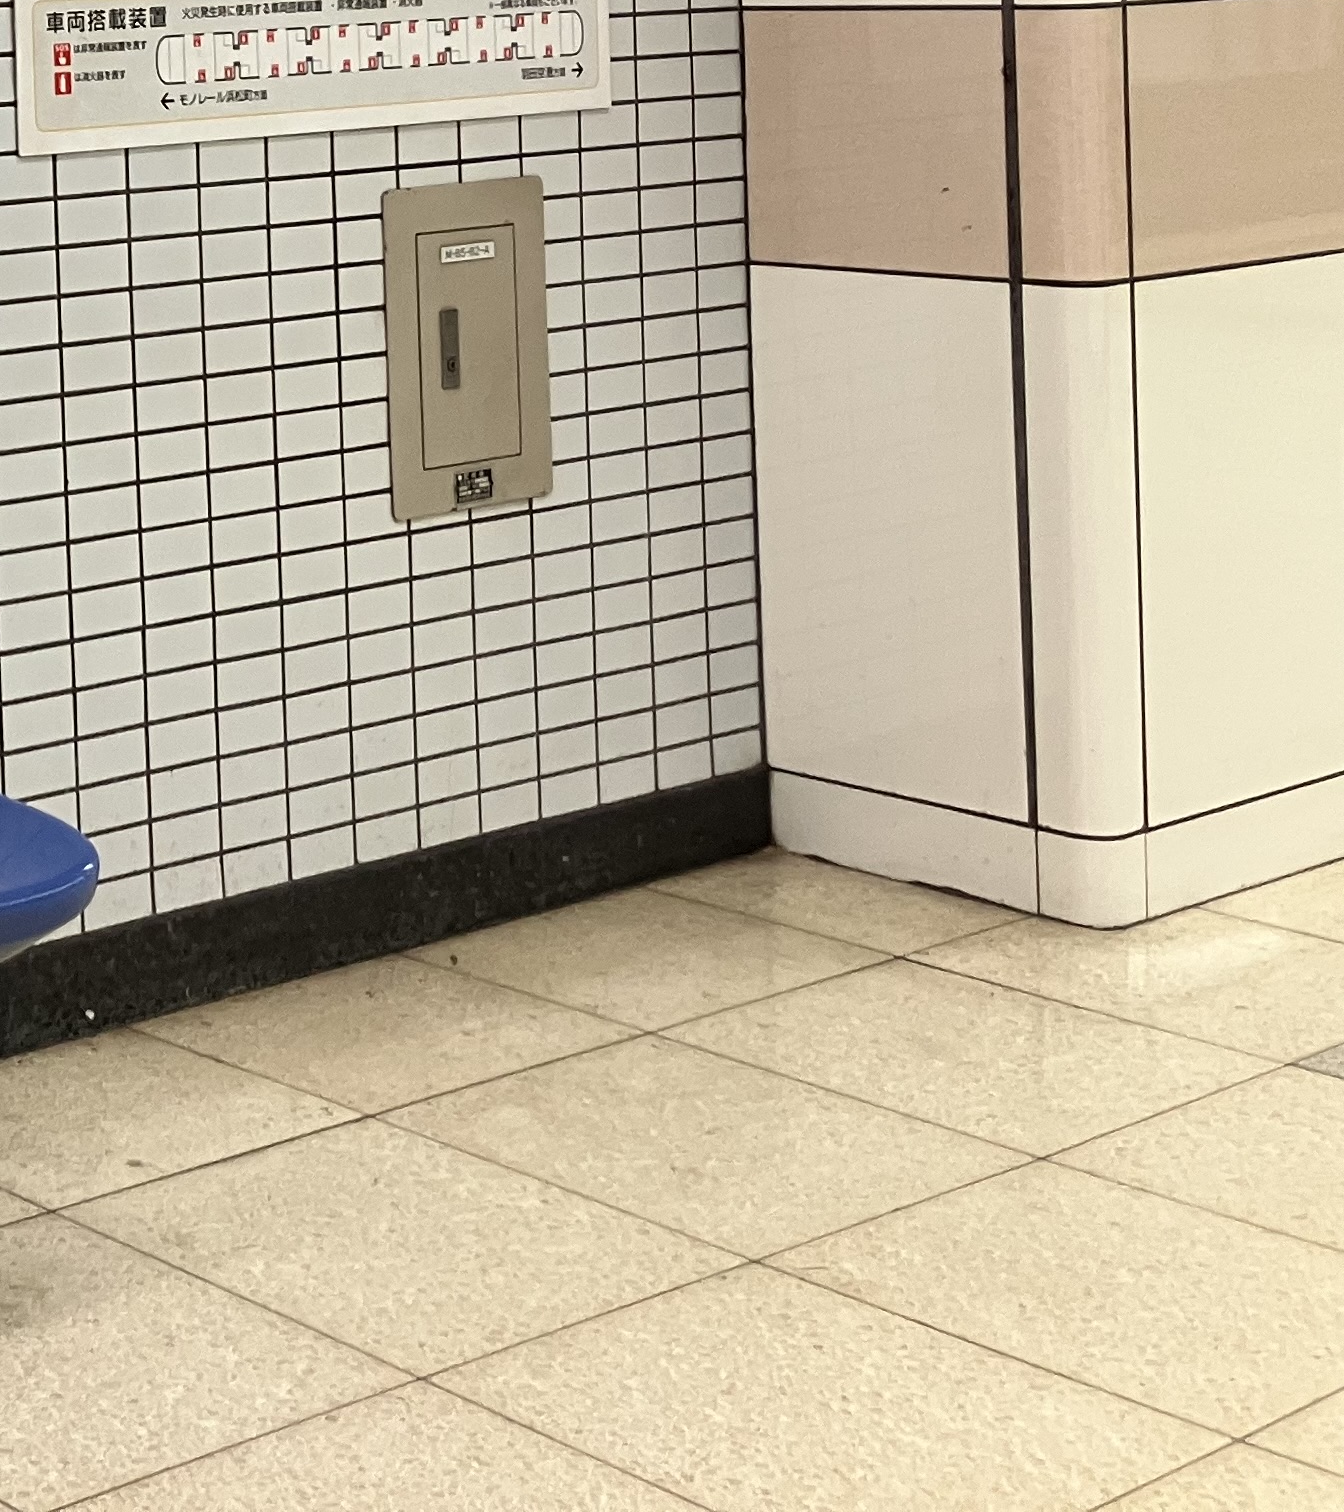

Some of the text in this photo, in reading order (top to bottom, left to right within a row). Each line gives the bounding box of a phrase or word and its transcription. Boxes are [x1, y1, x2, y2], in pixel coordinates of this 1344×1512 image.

[46, 6, 167, 33] 車両搭載装置
